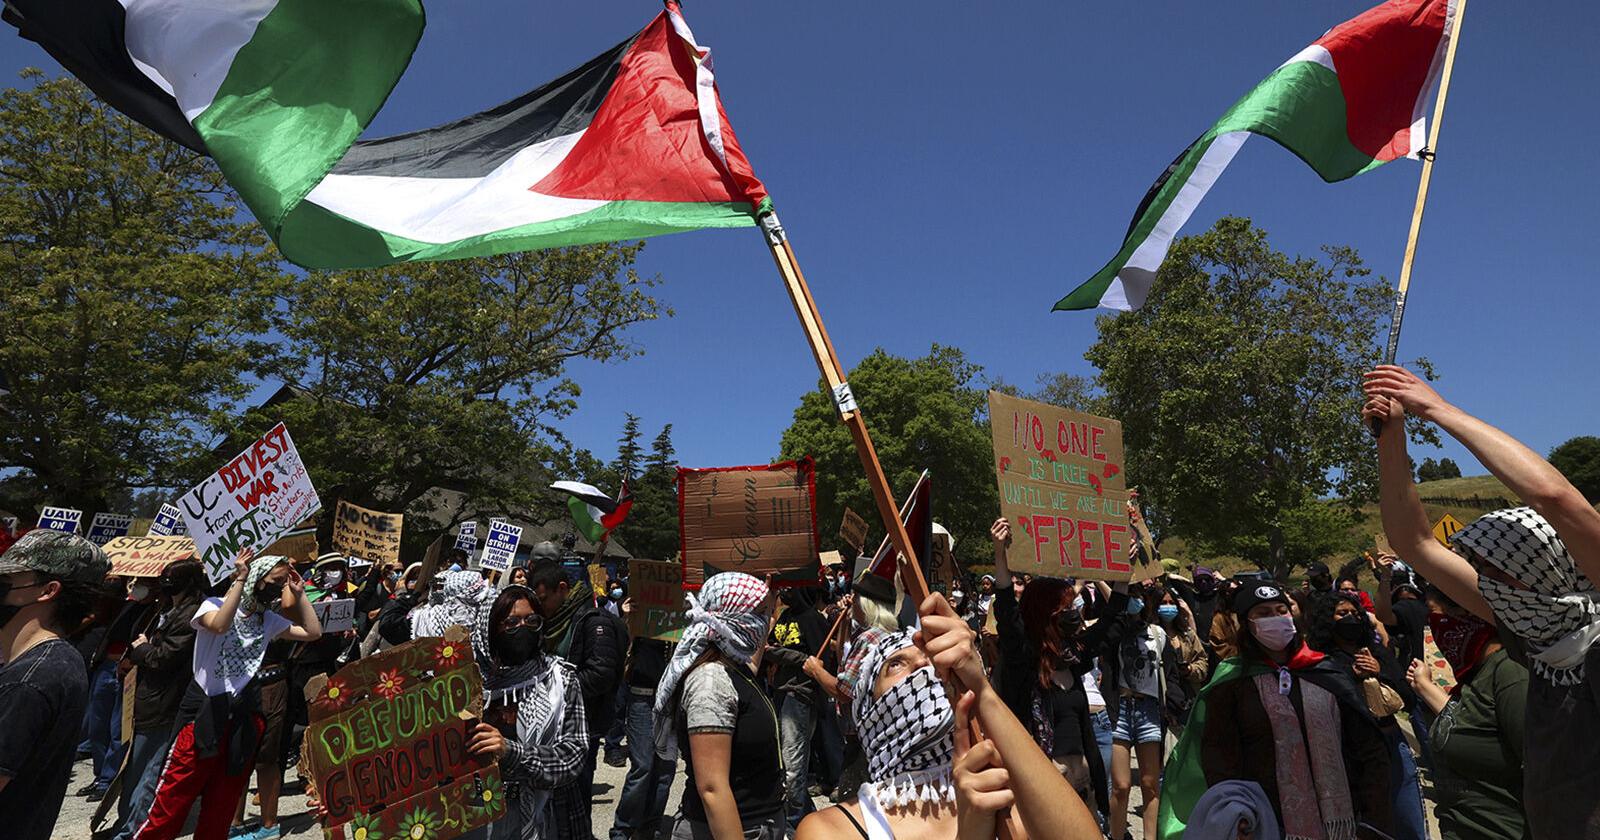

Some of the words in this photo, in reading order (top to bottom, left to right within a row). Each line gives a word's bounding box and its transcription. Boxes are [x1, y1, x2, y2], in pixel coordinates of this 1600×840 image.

[1013, 411, 1045, 452] NO
[1057, 419, 1107, 463] ONE
[218, 424, 290, 494] DIVEST
[1028, 457, 1045, 480] IS
[1052, 461, 1090, 486] FREE
[204, 509, 234, 535] from
[235, 470, 279, 512] WAR
[1002, 481, 1046, 510] UNTIL
[1050, 491, 1069, 511] WE
[1077, 495, 1097, 513] ARE
[1102, 497, 1124, 517] ALL
[44, 508, 80, 520] UAW
[161, 505, 181, 518] UAW
[339, 502, 360, 524] NO
[49, 521, 66, 529] ON
[95, 517, 131, 528] UAW
[260, 518, 271, 532] in
[730, 476, 761, 566] Crown
[102, 528, 117, 536] ON
[493, 522, 521, 535] UAW
[90, 535, 110, 543] STRI
[112, 537, 167, 551] STOP
[458, 535, 477, 544] UAW
[498, 534, 510, 542] ON
[1031, 513, 1132, 573] FREE
[488, 540, 515, 551] STRIKE
[487, 555, 507, 563] LABOR
[488, 548, 510, 558] UNFAIR
[112, 560, 165, 575] MACHIN
[638, 564, 680, 584] PALES
[320, 674, 470, 765] DEFUND
[325, 727, 464, 818] GENOCID
